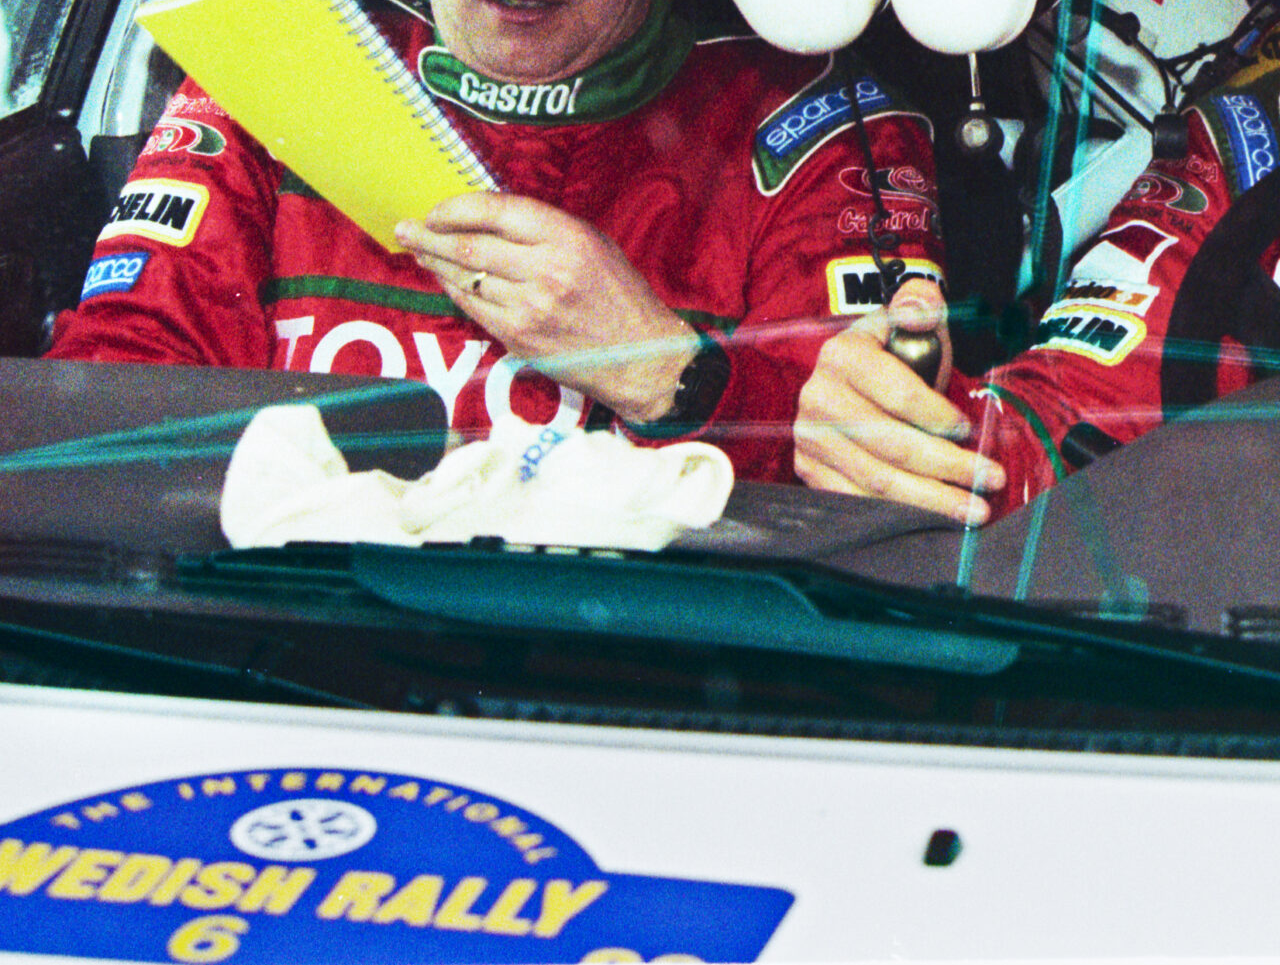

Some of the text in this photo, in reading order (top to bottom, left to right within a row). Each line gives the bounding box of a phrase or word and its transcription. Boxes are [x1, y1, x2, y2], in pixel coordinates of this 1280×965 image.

[459, 72, 584, 116] Castrol
[51, 770, 558, 865] THE INTERNATIONAL
[315, 869, 609, 939] RALLY
[166, 913, 250, 964] 6
